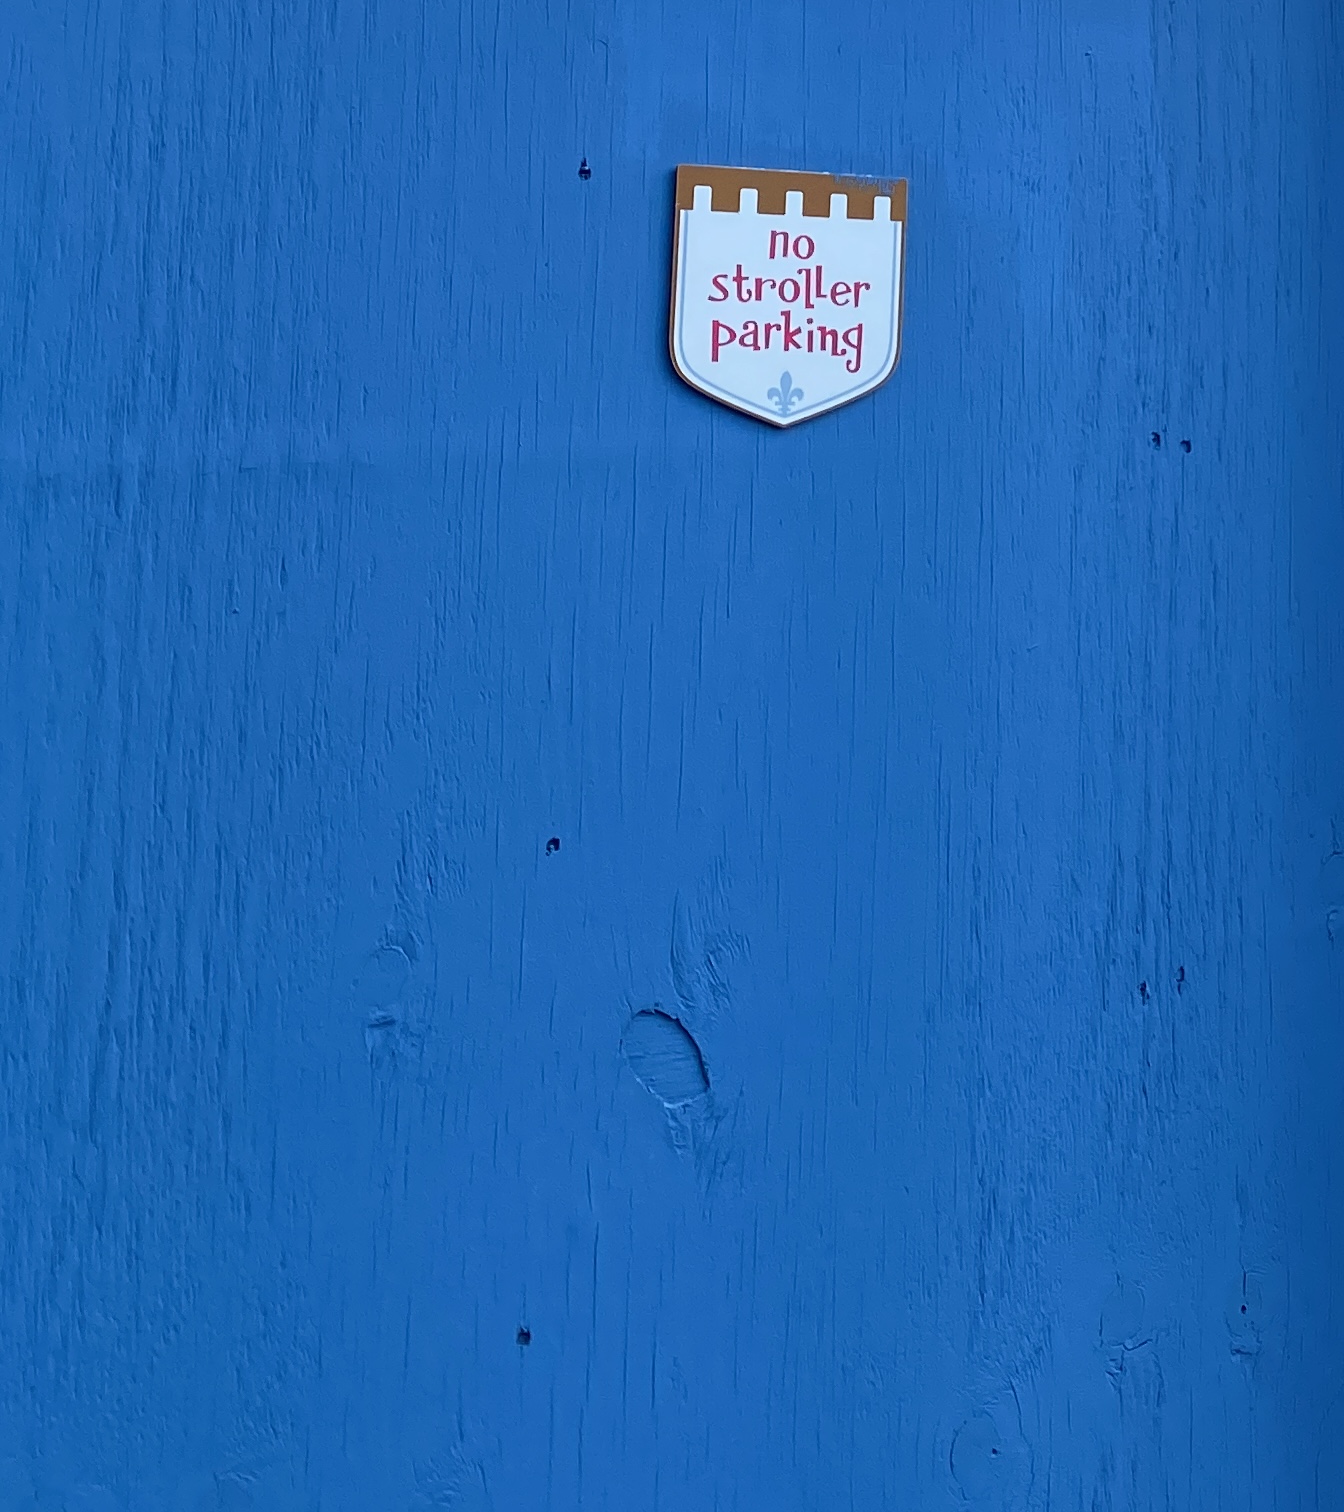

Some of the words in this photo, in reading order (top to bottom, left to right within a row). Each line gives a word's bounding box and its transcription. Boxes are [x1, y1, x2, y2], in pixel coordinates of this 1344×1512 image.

[768, 229, 815, 260] no
[707, 263, 871, 309] stroller
[711, 309, 863, 373] parking
